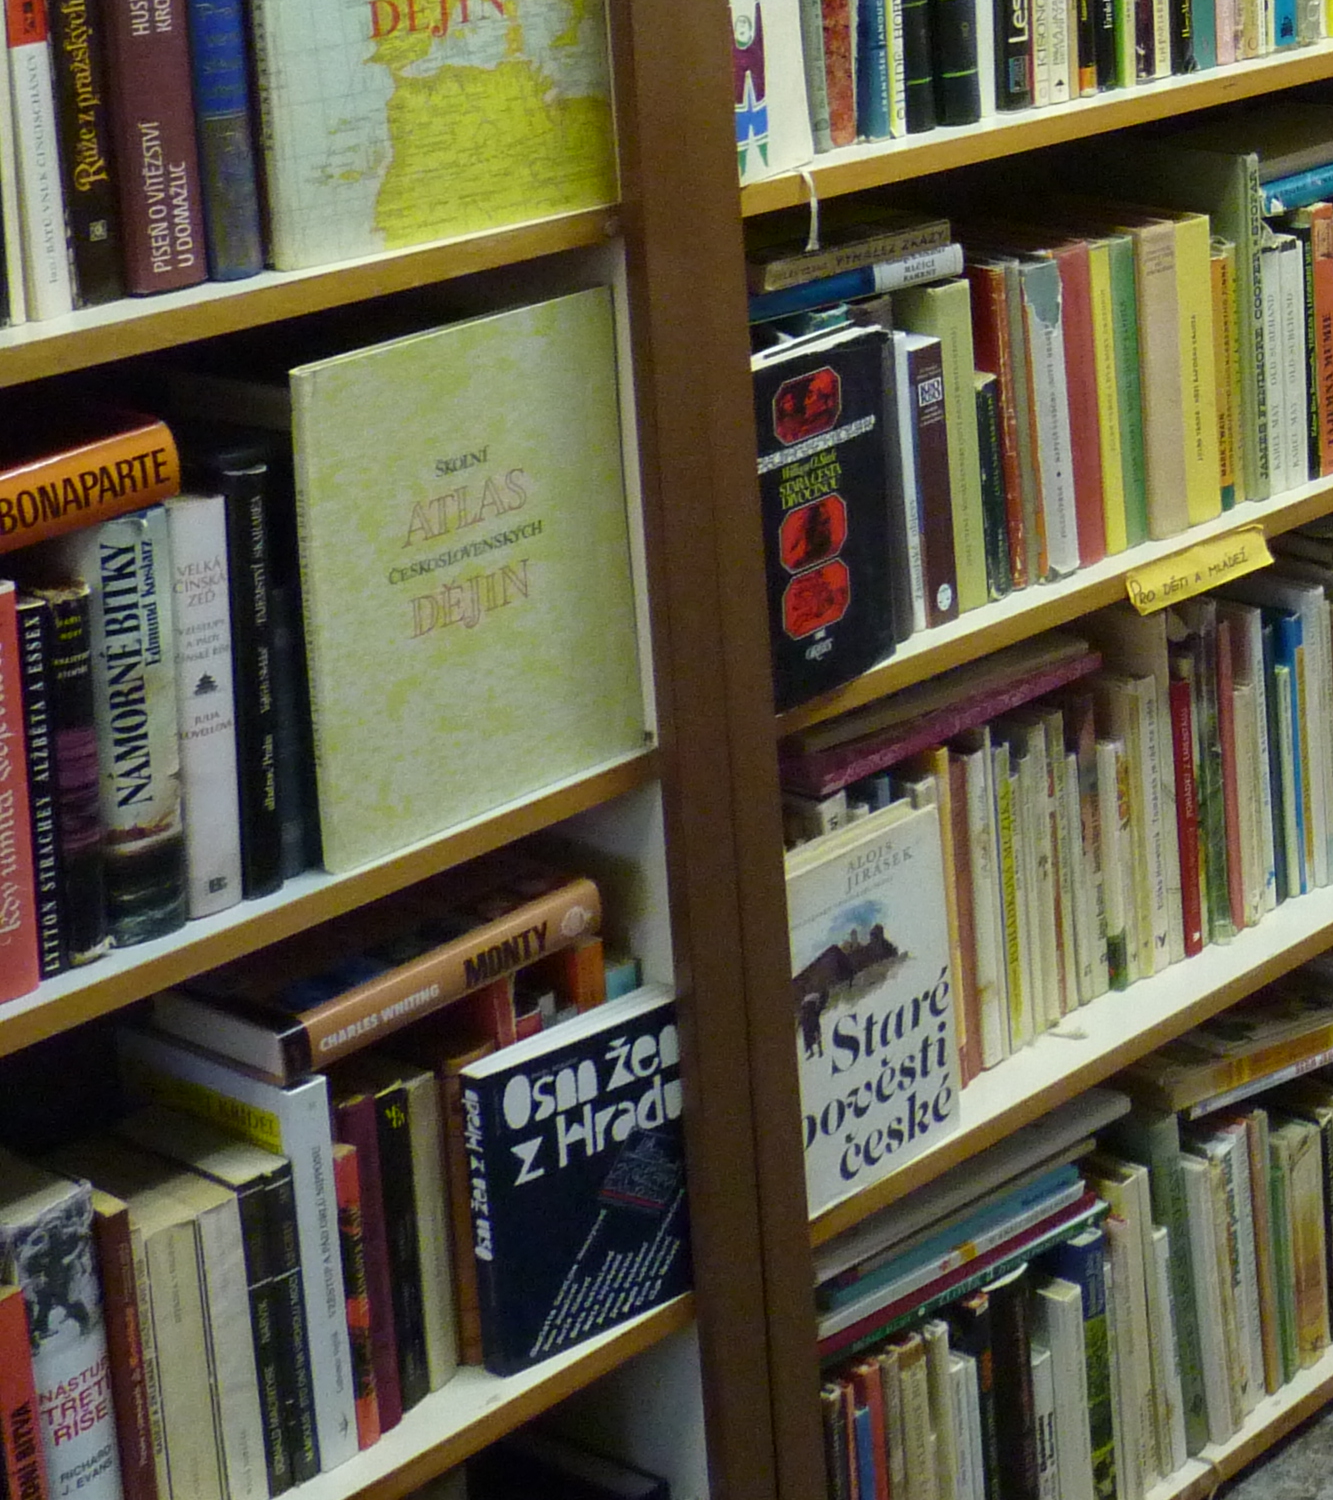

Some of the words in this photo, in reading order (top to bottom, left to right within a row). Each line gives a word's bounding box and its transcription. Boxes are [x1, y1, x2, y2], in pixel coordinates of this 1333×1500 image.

[73, 129, 110, 192] Růže
[137, 121, 167, 204] VÍTĚZSTVÍ
[150, 204, 169, 219] O
[168, 161, 194, 251] DOMAŽLIC
[148, 221, 174, 274] PÍSEŇ
[176, 252, 195, 268] U
[1251, 252, 1263, 321] COOPER
[1254, 326, 1266, 420] FENIMORE
[1321, 313, 1333, 369] MUMIE
[433, 445, 490, 478] ŠKOLNÍ
[1257, 422, 1269, 480] JAMES
[0, 446, 171, 538] BONAPARTE
[401, 467, 529, 550] ATLAS
[388, 518, 544, 586] ČESKOSLOVENSKÝCH
[98, 543, 142, 637] BITKY
[410, 557, 532, 640] DĚJIN
[23, 616, 43, 675] ESSEX
[141, 601, 162, 666] Edmund
[30, 682, 45, 693] A
[100, 639, 153, 809] NÁMORNÉ
[34, 796, 58, 892] STRACHEY
[462, 919, 550, 991] MONTY
[320, 1012, 380, 1052] CHARLES
[830, 963, 951, 1079] Staré
[502, 1058, 600, 1130] Osm
[839, 1071, 953, 1183] české
[509, 1135, 546, 1187] z
